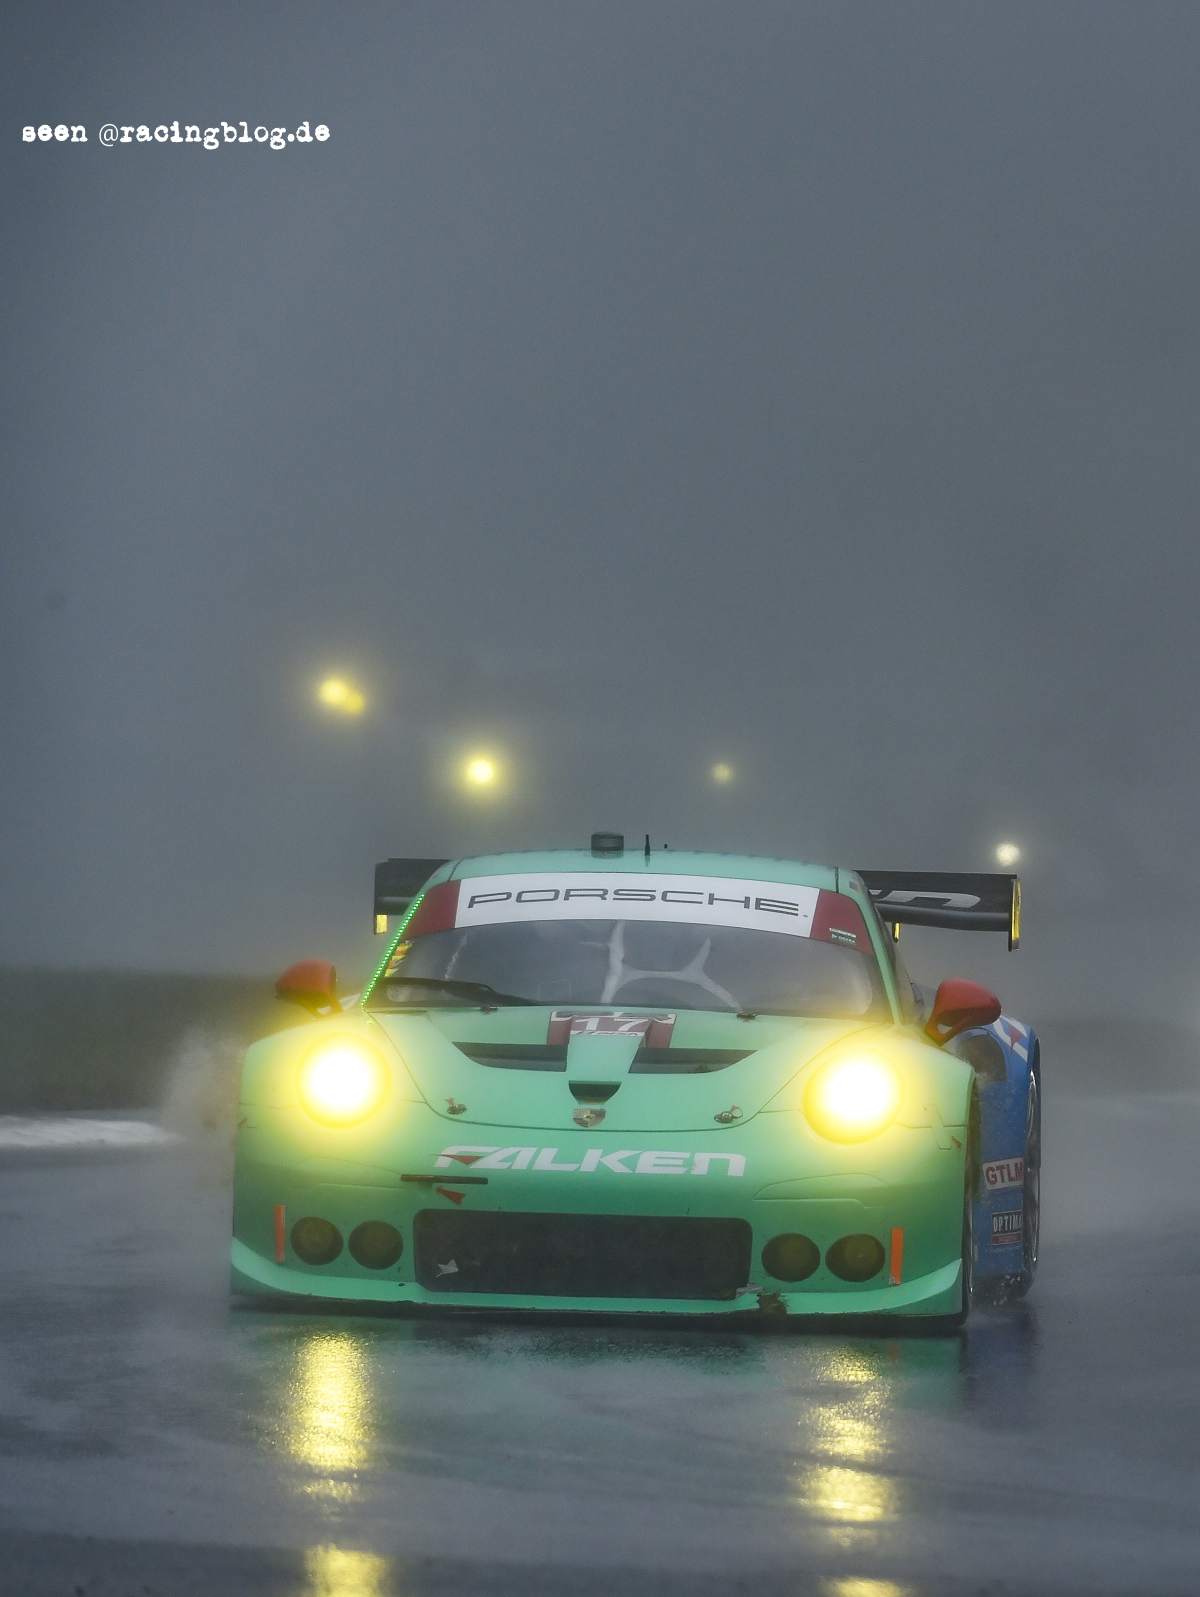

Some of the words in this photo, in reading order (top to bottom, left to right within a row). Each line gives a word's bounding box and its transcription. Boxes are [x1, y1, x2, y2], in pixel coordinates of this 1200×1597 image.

[468, 888, 799, 917] PORSCHE
[575, 1017, 648, 1032] 17
[434, 1145, 747, 1177] FALKEN
